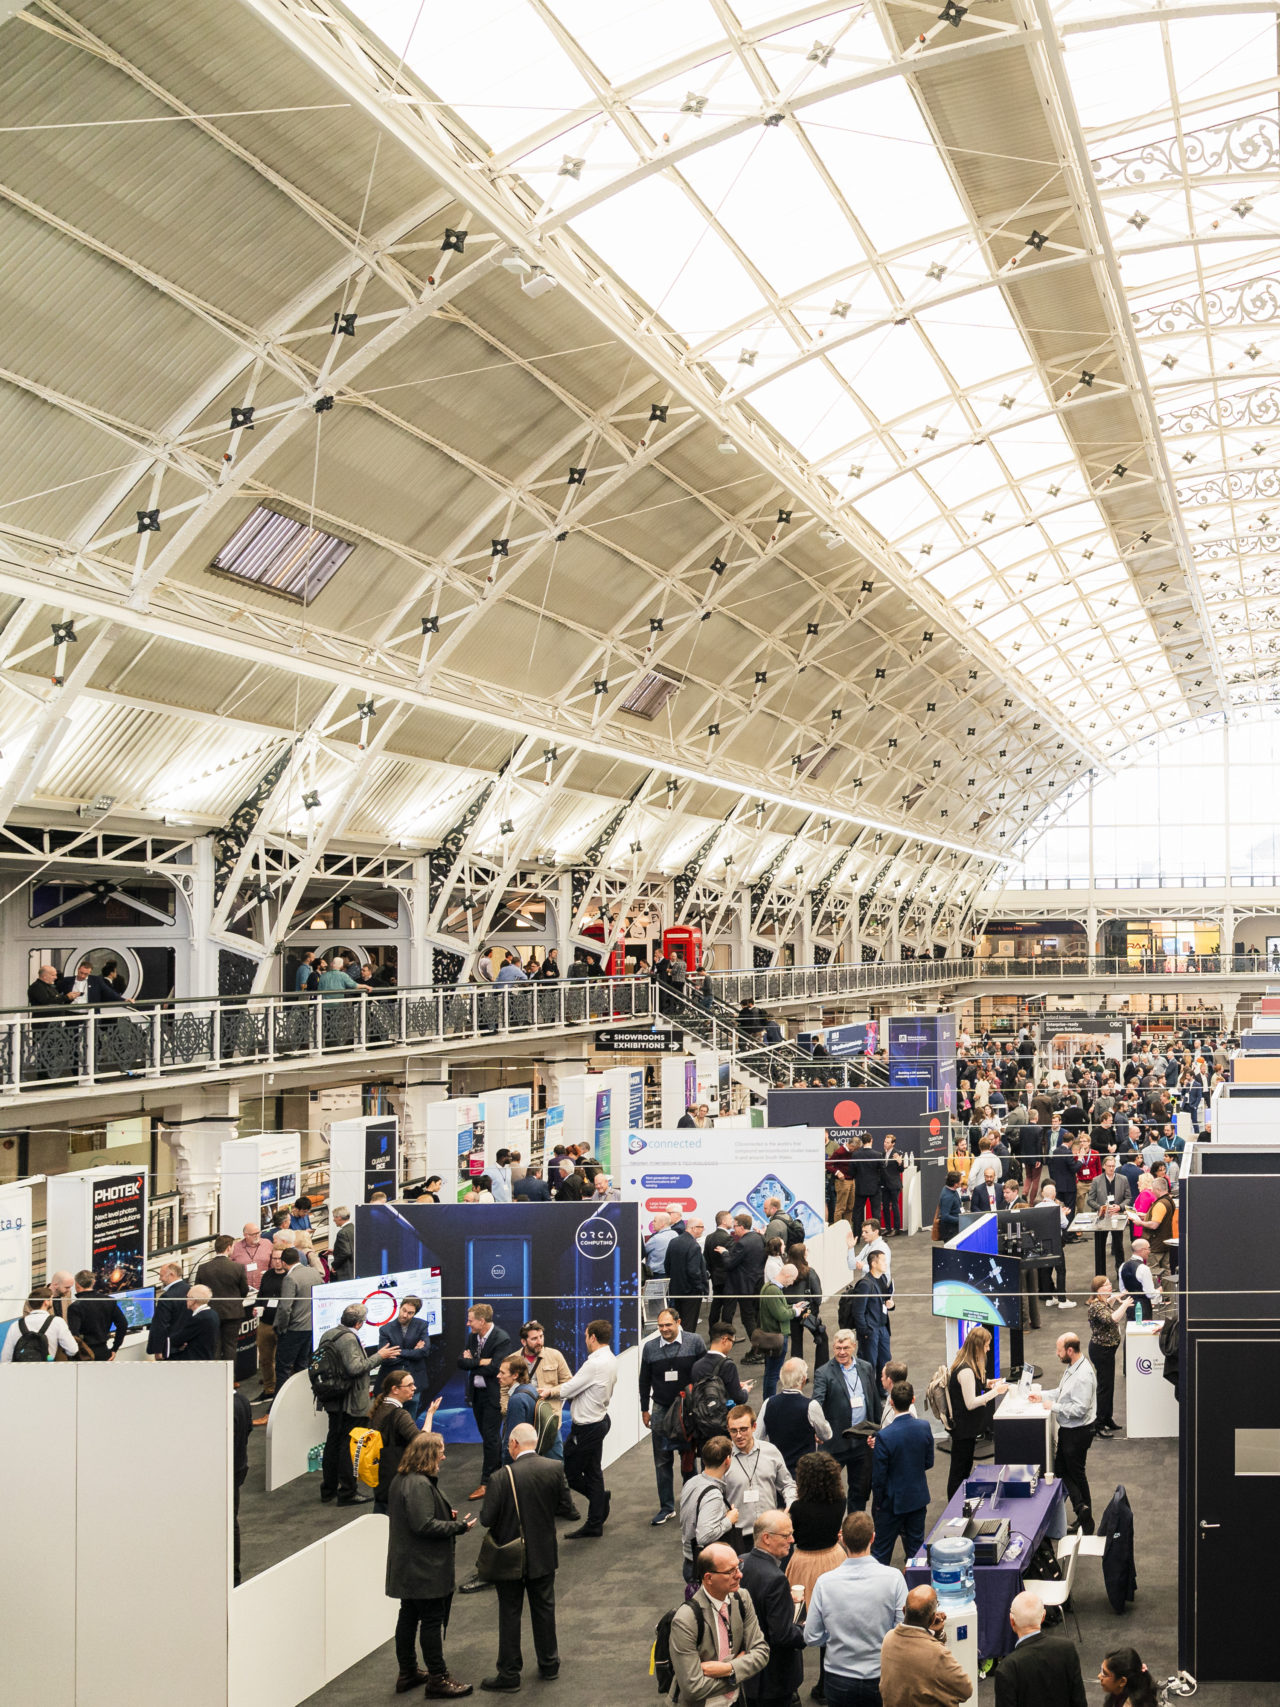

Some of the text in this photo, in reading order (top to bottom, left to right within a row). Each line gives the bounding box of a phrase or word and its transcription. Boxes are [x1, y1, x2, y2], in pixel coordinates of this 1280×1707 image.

[649, 1138, 702, 1149] connected
[94, 1182, 140, 1204] PHOTEK
[94, 1213, 142, 1230] detection solutions
[95, 1206, 138, 1222] Next level photon
[580, 1231, 613, 1239] ORCA
